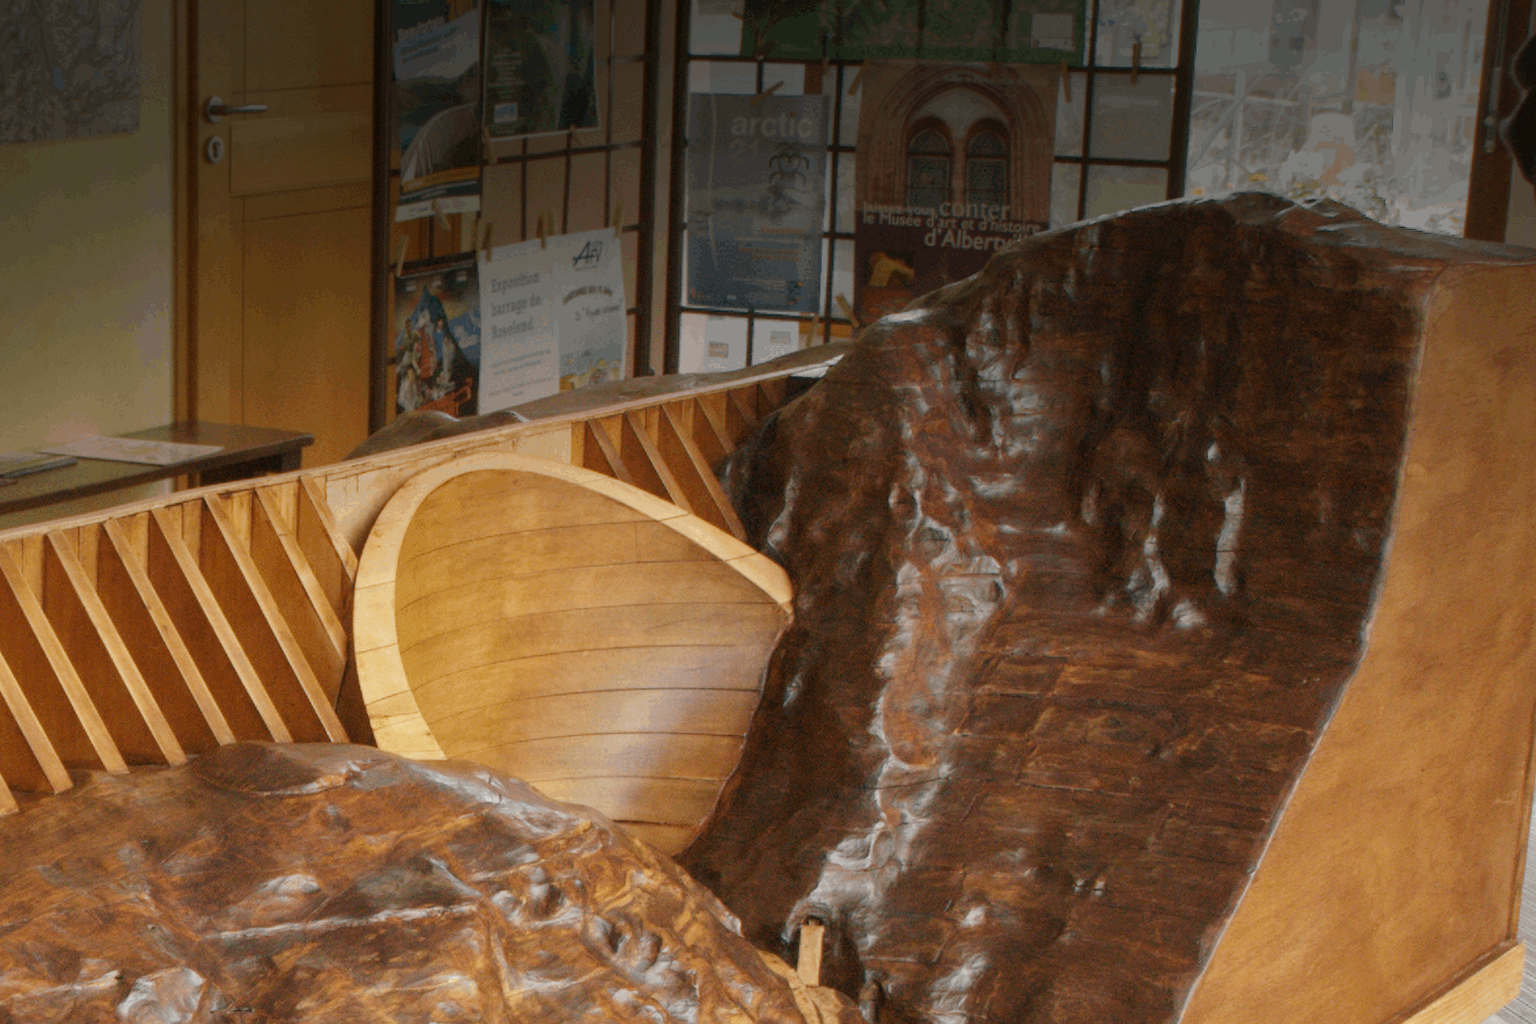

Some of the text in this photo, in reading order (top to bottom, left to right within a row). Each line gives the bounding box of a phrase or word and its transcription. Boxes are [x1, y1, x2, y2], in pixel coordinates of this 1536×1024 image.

[730, 112, 817, 137] arctic
[938, 201, 1012, 219] conter
[879, 213, 922, 228] Musée
